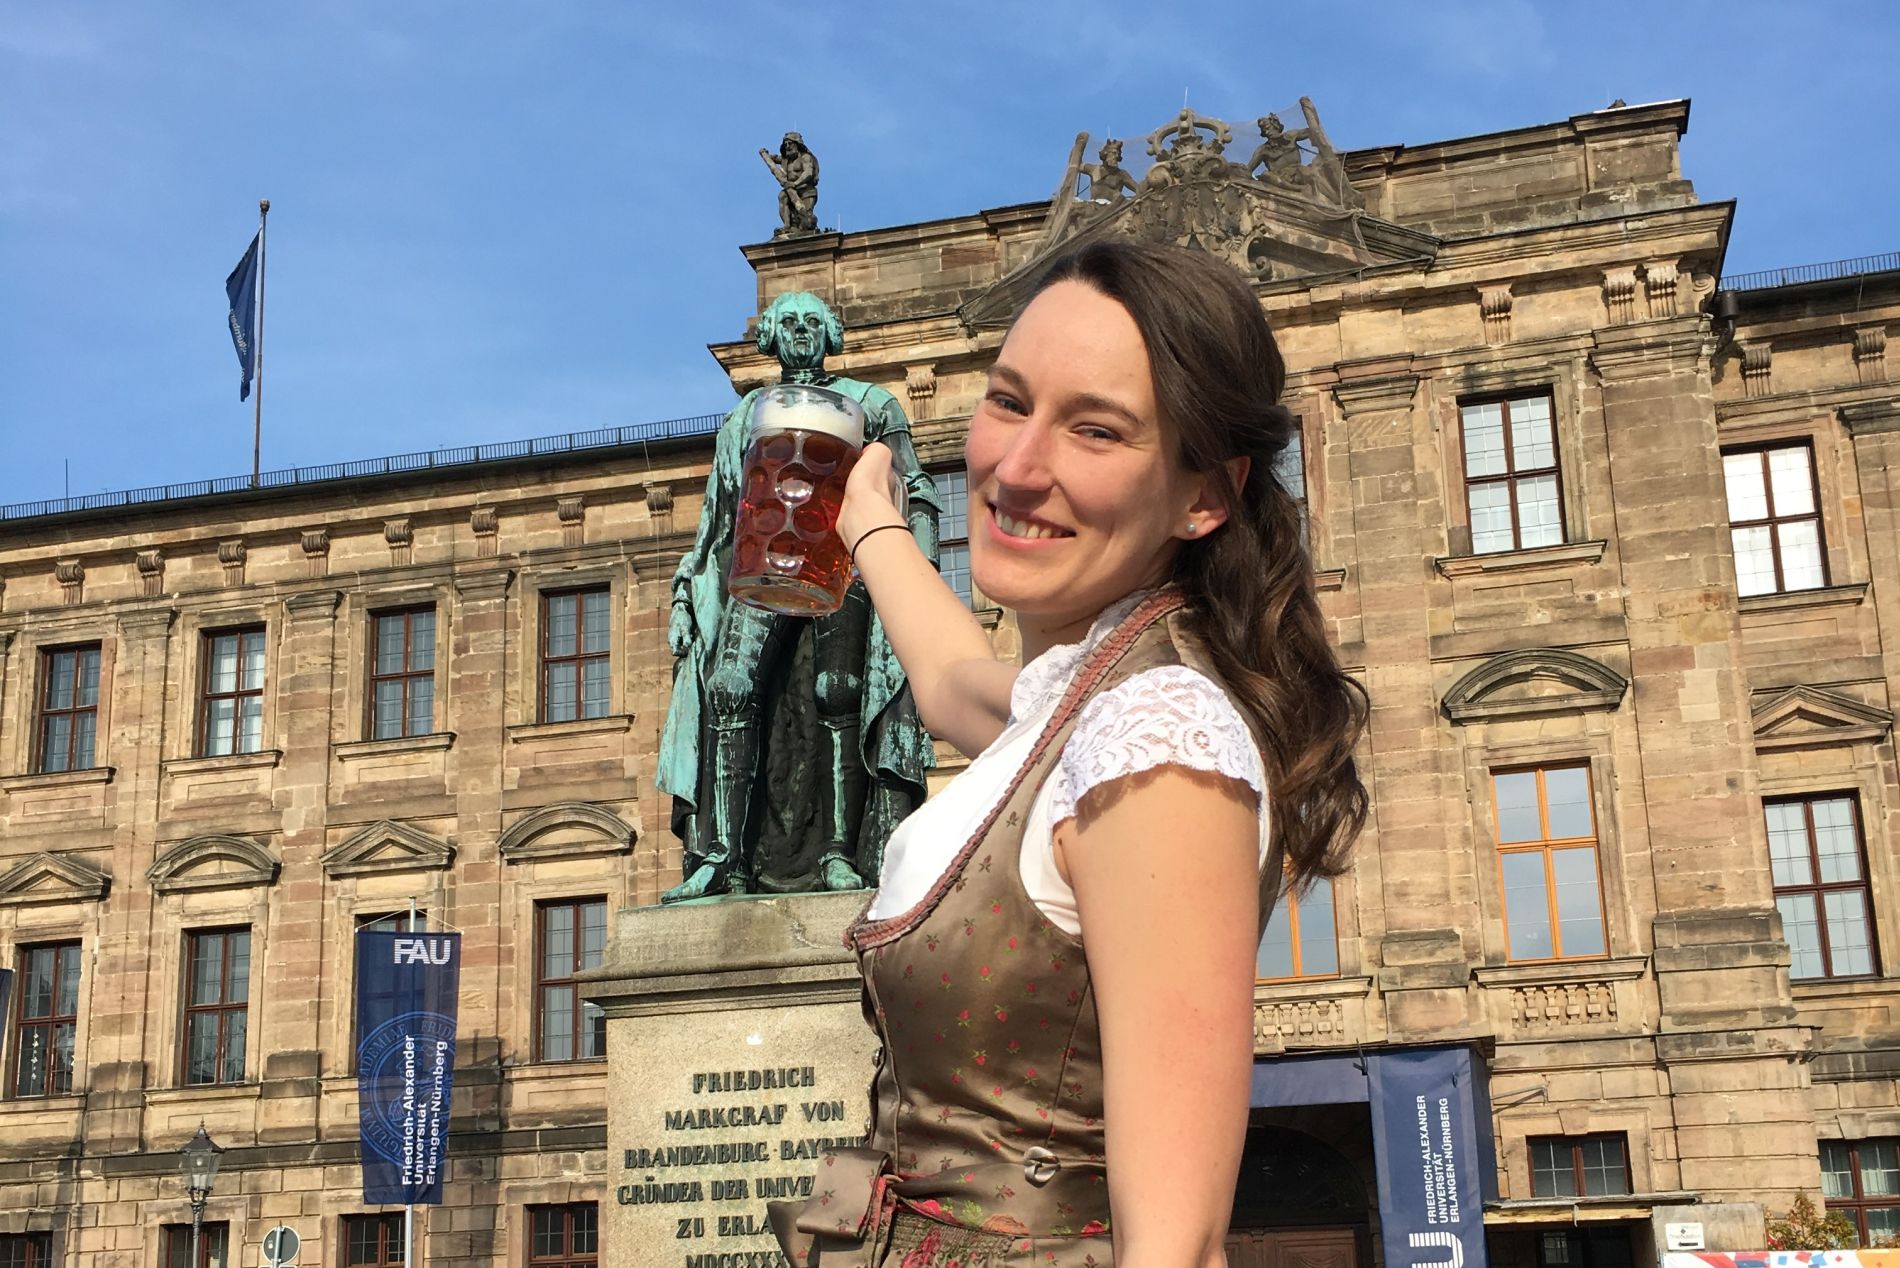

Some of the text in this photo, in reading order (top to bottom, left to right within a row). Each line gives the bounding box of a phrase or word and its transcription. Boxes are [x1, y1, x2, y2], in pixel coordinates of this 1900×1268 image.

[394, 939, 451, 964] FAU
[402, 1034, 416, 1185] Friedrich-Alexander
[426, 1040, 448, 1185] Erlangen-Nürnberg
[692, 1066, 816, 1094] FRIEDRICH
[414, 1103, 427, 1185] Universität
[665, 1101, 845, 1131] MARKGRAF VON
[616, 1176, 704, 1205] GRÜNDER
[711, 1178, 749, 1200] DER
[1416, 1095, 1438, 1224] FRIEDRICH-ALEXANDER
[1433, 1152, 1449, 1223] UNIVERSITÄT
[1439, 1098, 1460, 1223] ERLANGEN-NÜRNBERG
[676, 1214, 776, 1239] ZU ERLA
